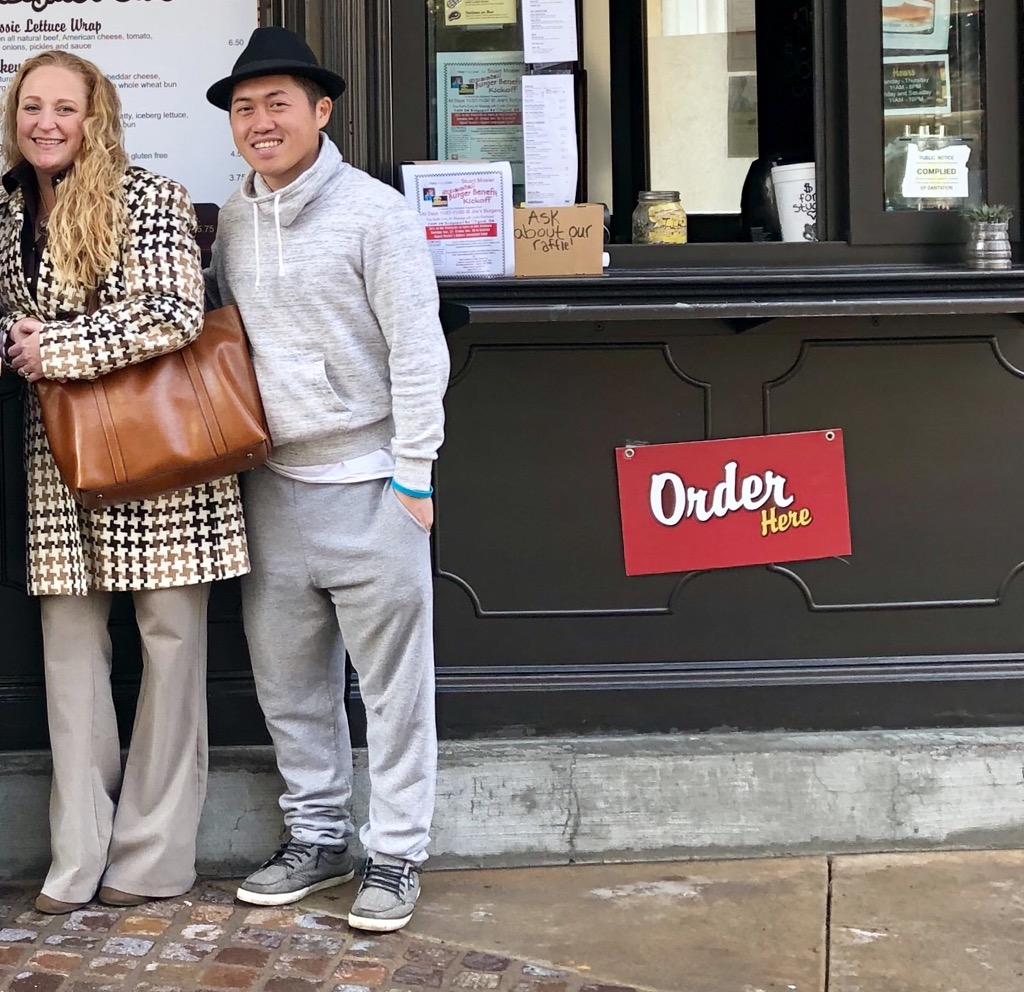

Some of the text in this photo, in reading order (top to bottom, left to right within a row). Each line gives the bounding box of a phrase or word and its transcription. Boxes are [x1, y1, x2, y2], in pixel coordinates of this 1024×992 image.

[24, 19, 66, 33] Lettuce
[70, 18, 102, 34] Wrap
[514, 225, 592, 240] about our
[650, 461, 794, 526] Order
[761, 506, 813, 536] Here
